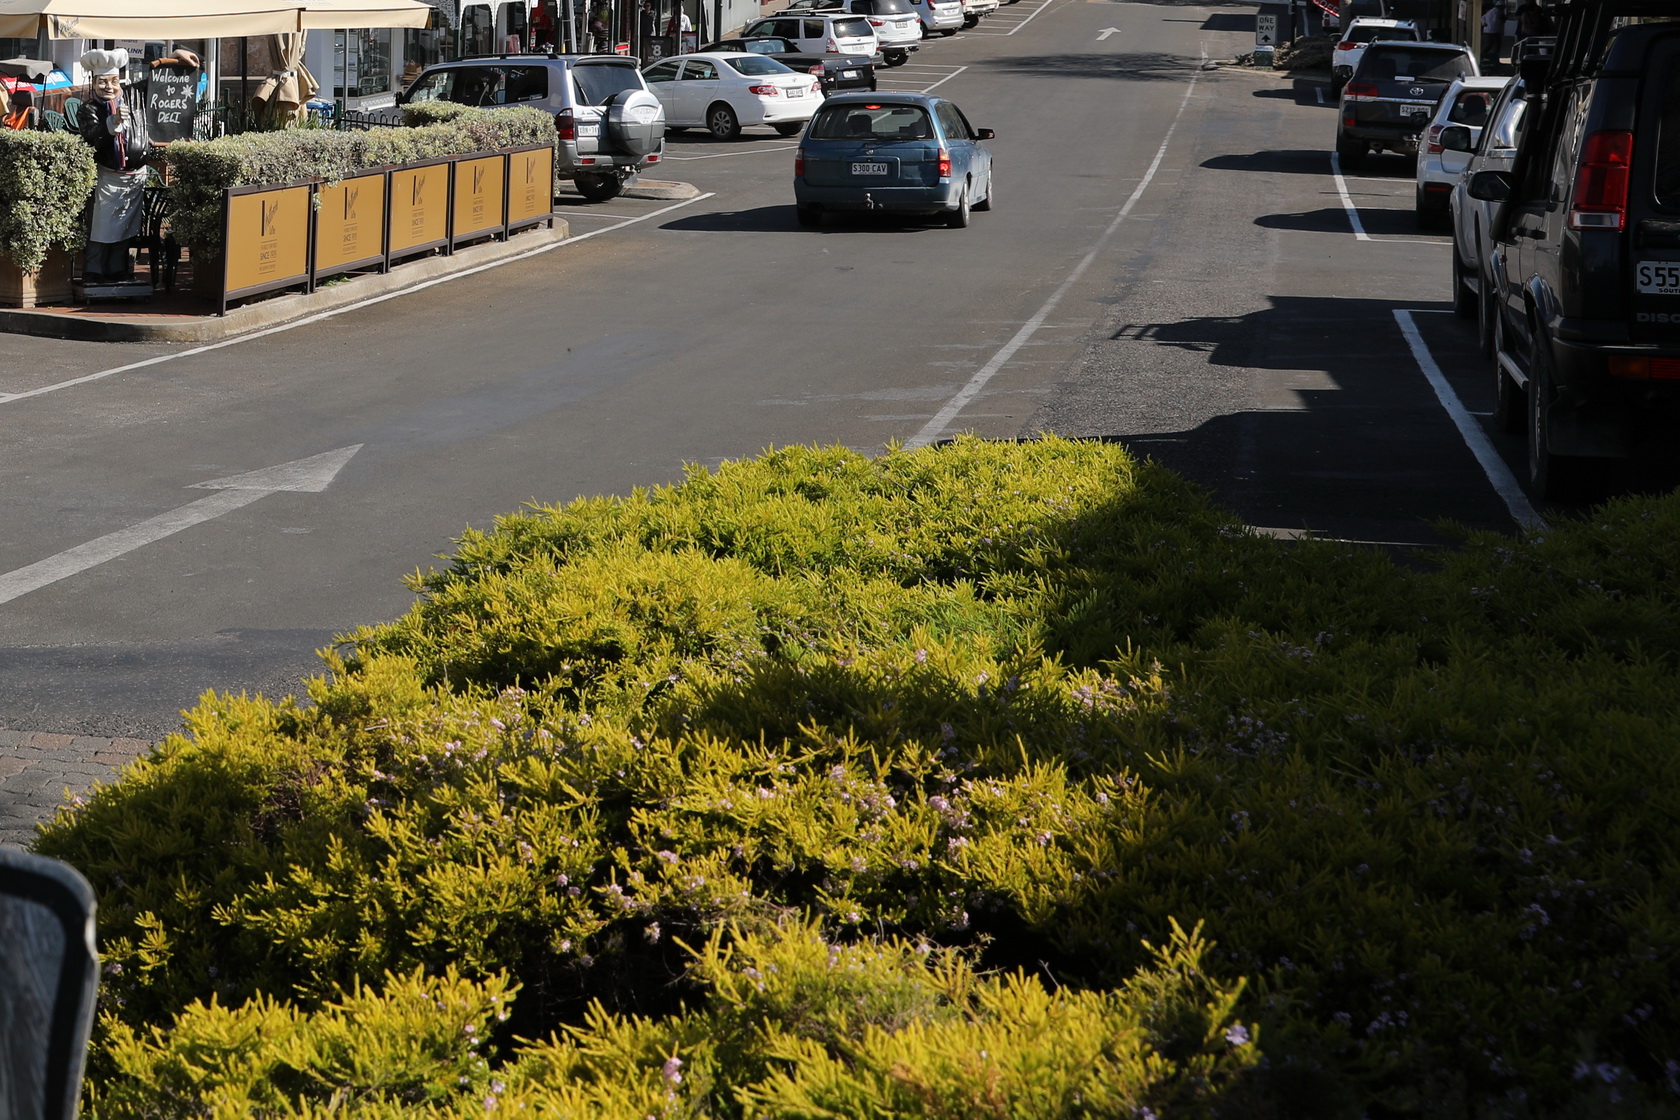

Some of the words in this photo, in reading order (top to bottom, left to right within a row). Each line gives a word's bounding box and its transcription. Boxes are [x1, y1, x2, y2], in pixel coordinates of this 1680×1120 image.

[1259, 16, 1274, 24] ONE
[152, 68, 190, 83] Welcome
[166, 85, 175, 96] to
[157, 112, 181, 124] DELI
[853, 165, 870, 173] S300
[872, 165, 886, 173] CAV
[1639, 266, 1680, 288] S55
